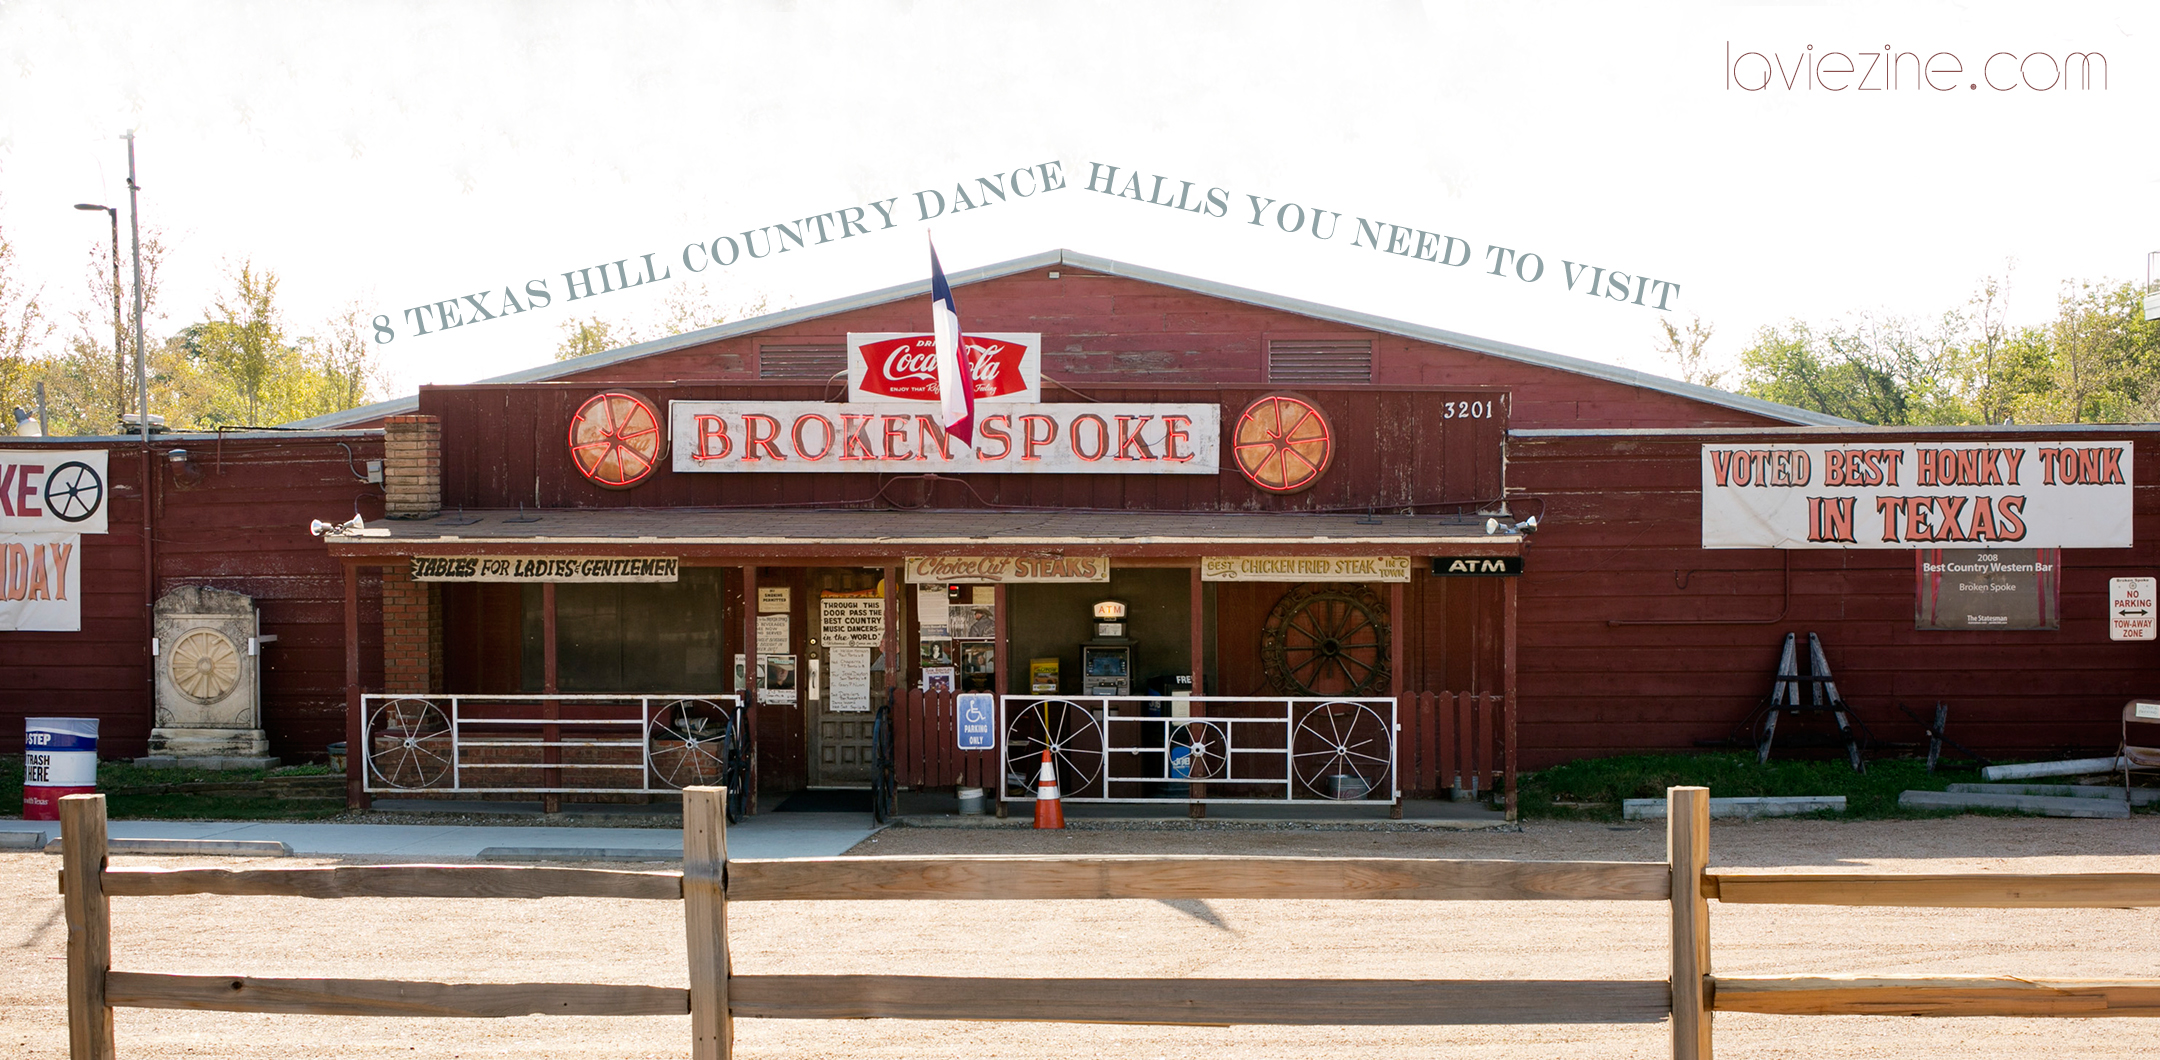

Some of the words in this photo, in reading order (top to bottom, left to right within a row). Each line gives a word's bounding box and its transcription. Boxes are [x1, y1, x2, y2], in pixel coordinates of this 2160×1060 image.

[916, 340, 936, 348] DRI
[1443, 400, 1493, 419] 3201
[691, 413, 955, 463] BROKEN
[975, 413, 1196, 463] SPOKE
[1709, 449, 1812, 488] VOTED
[1824, 448, 1905, 488] BEST
[1916, 447, 2026, 487] HONKY
[2038, 447, 2126, 487] TONK
[1806, 495, 1858, 544] IN
[1876, 495, 2028, 544] TEXAS
[1977, 553, 1999, 562] 2008
[415, 557, 479, 578] TABLES
[481, 559, 511, 577] FOR
[513, 558, 577, 578] LADIES
[581, 558, 677, 577] GENTLEMEN
[917, 556, 976, 577] Choice
[977, 557, 1011, 576] Cut
[1014, 556, 1097, 578] STEAKS
[1207, 561, 1235, 571] BEST
[1241, 559, 1296, 574] CHICKEN
[1297, 559, 1331, 574] FRIED
[1335, 559, 1378, 575] STEAK
[1384, 560, 1396, 568] IN
[1448, 559, 1507, 573] ATM
[1923, 562, 1946, 572] Best
[1947, 562, 1988, 574] Country
[1990, 562, 2034, 572] Western
[2035, 562, 2053, 572] Bar
[1378, 568, 1405, 578] TOWN
[1959, 583, 1989, 592] Broken
[1990, 583, 2017, 593] Spoke
[2126, 590, 2140, 598] NO
[2114, 600, 2152, 608] PARKING
[1098, 606, 1122, 614] ATM
[1978, 614, 2008, 622] Statesman
[2114, 620, 2152, 628] TOW-AWAY
[2123, 630, 2143, 638] ZONE
[1176, 675, 1192, 684] FRE
[964, 724, 988, 734] PARKING
[969, 736, 984, 745] ONLY
[27, 754, 50, 766] TRASH
[27, 766, 50, 782] HERE
